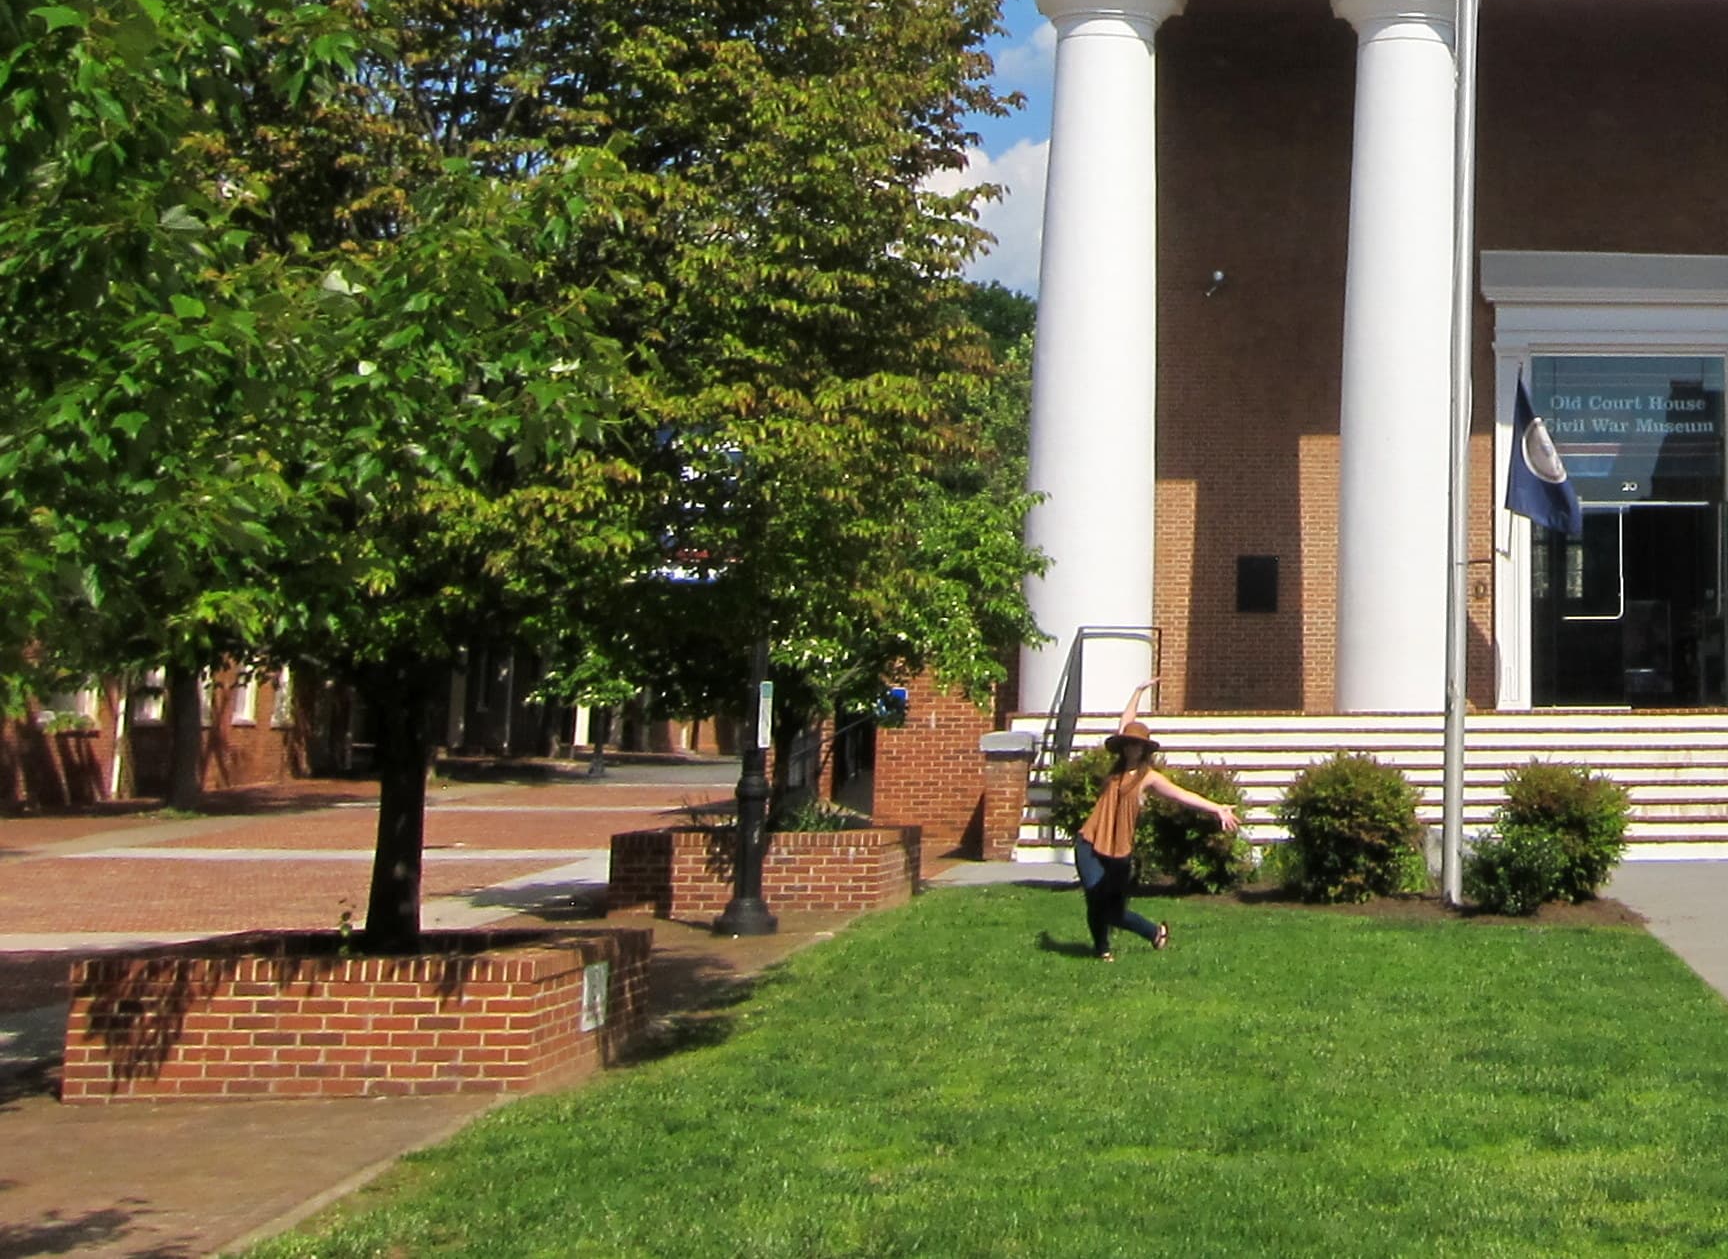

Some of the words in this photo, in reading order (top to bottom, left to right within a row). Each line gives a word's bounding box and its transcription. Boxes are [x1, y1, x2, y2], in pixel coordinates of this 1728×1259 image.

[1550, 395, 1582, 410] Old
[1588, 395, 1642, 410] Court
[1648, 395, 1706, 411] House
[1591, 418, 1629, 433] War
[1635, 418, 1714, 433] Museum
[1621, 481, 1638, 492] 20
